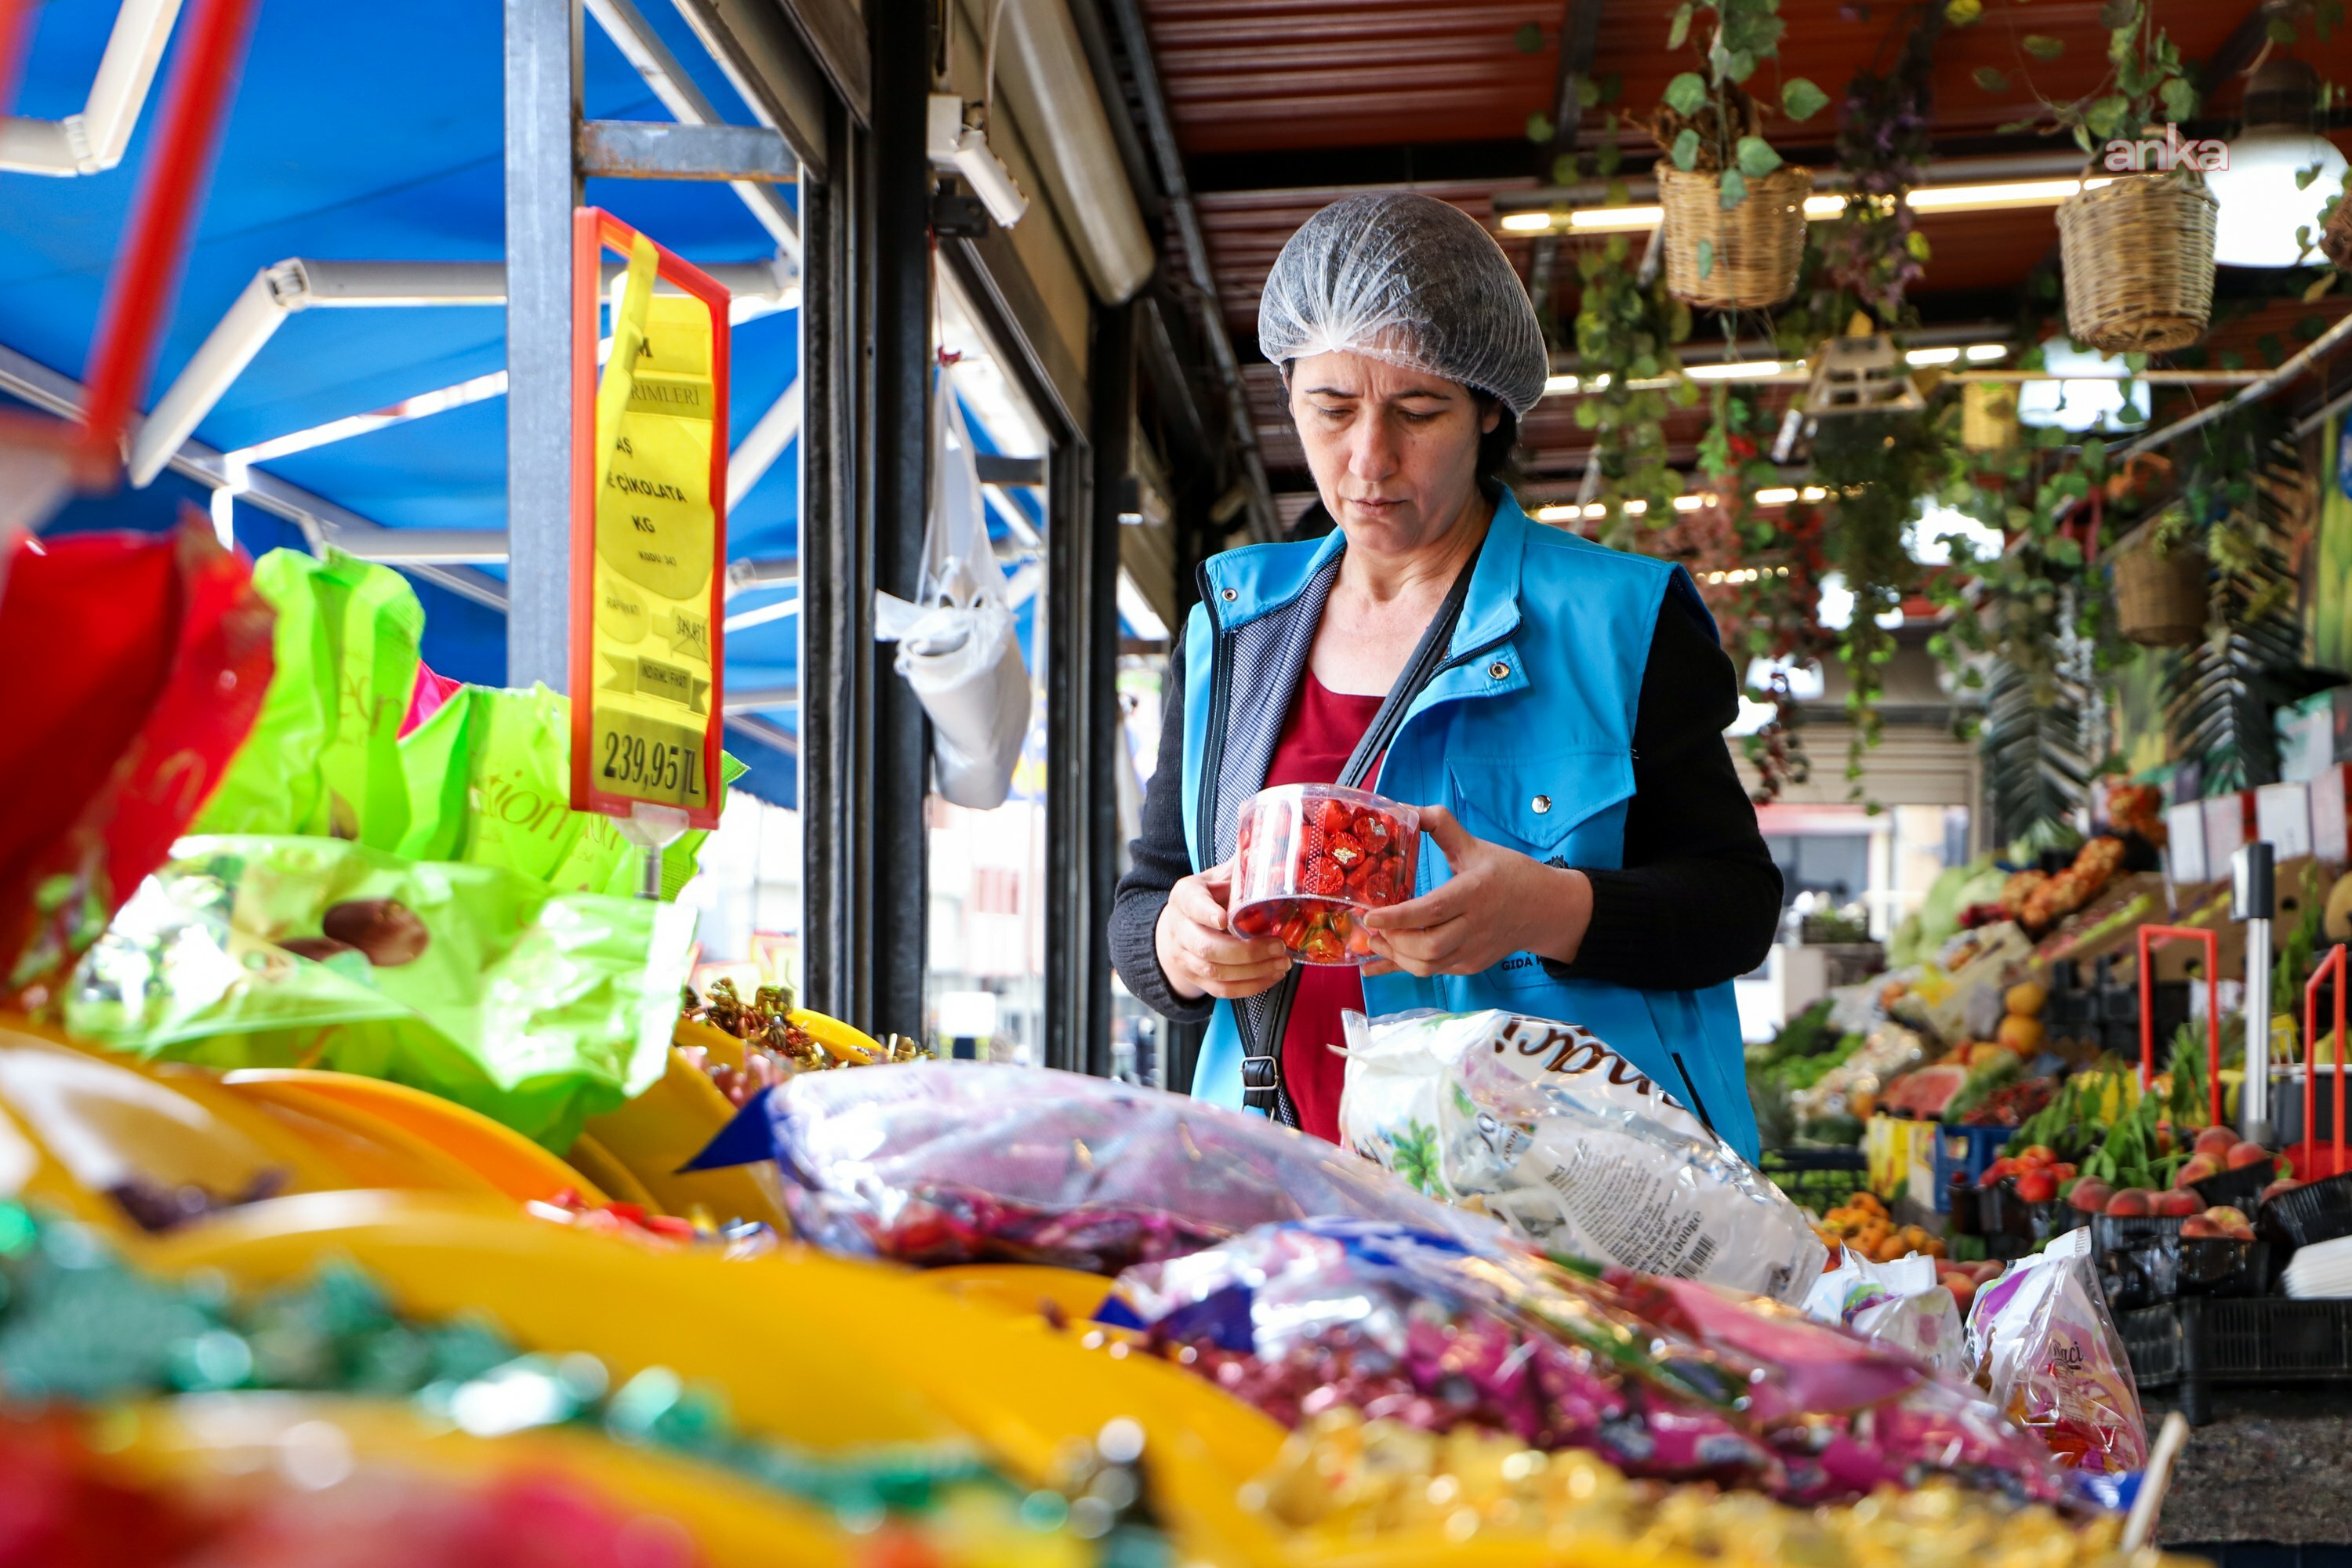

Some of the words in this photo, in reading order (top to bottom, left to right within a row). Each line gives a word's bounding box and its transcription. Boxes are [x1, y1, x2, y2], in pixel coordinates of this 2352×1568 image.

[616, 471, 688, 503] ÇİKOLATA
[631, 514, 655, 533] KG
[604, 731, 679, 791] 239,95
[684, 746, 699, 794] TL
[1501, 956, 1533, 971] GIDA
